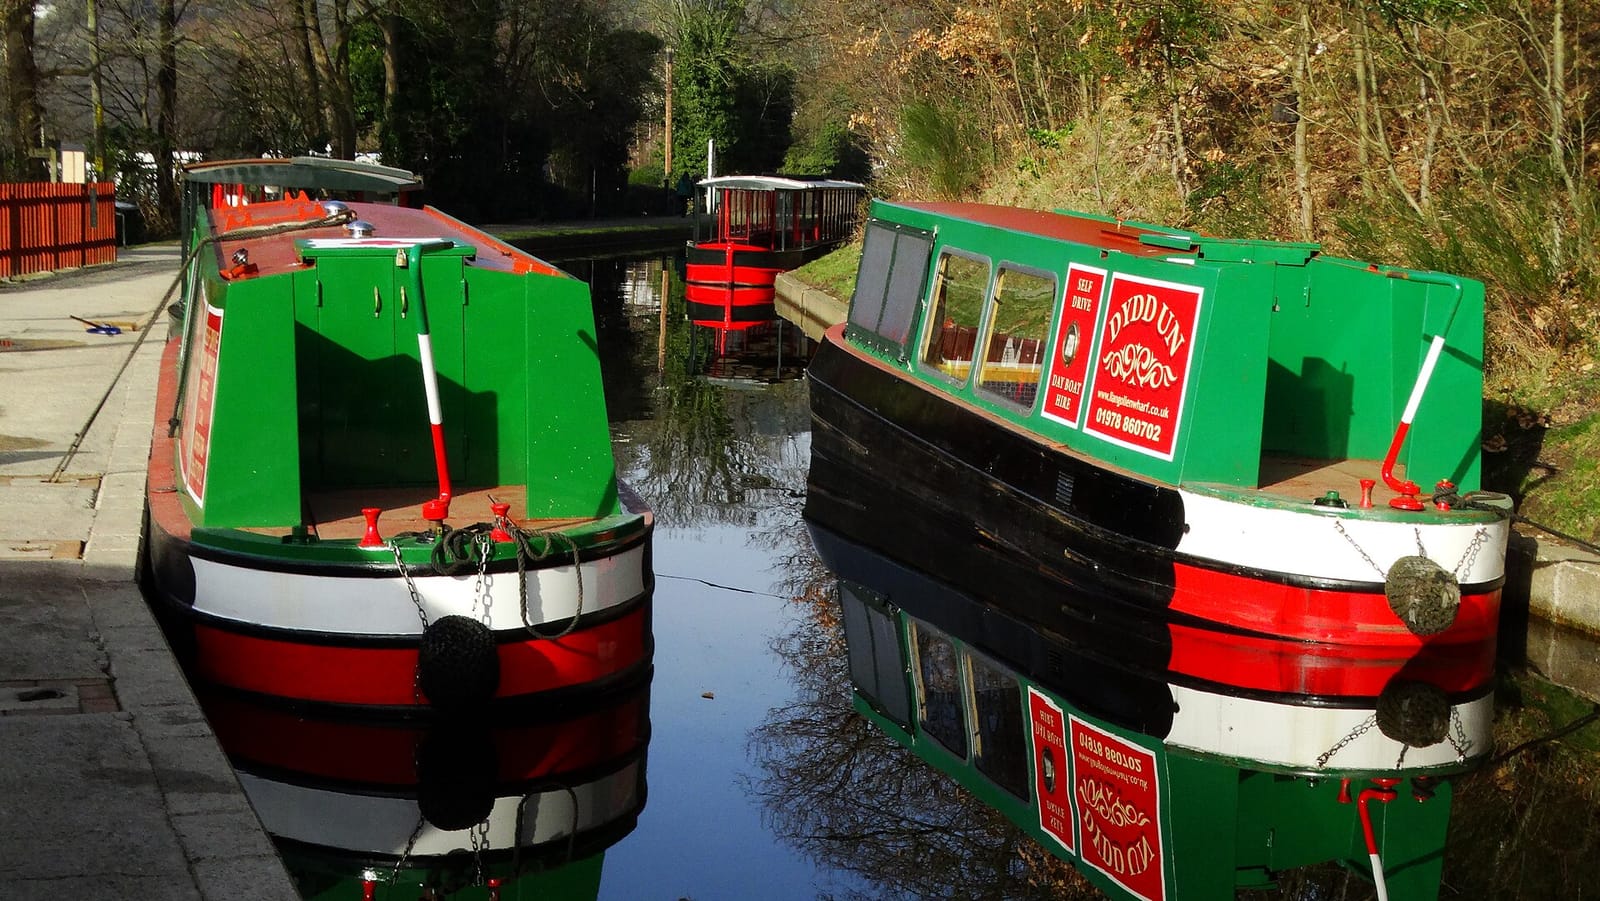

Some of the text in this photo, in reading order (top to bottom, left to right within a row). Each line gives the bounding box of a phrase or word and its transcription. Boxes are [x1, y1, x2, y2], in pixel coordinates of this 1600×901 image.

[1077, 278, 1094, 293] SELF
[1072, 295, 1092, 312] DRIVE
[1109, 293, 1186, 357] DYDD UN
[1052, 374, 1082, 395] DAY BOAT
[1055, 393, 1071, 410] HIRE
[1097, 390, 1169, 418] www.llangollenwharf.co.uk
[1096, 407, 1161, 442] 01978 860702
